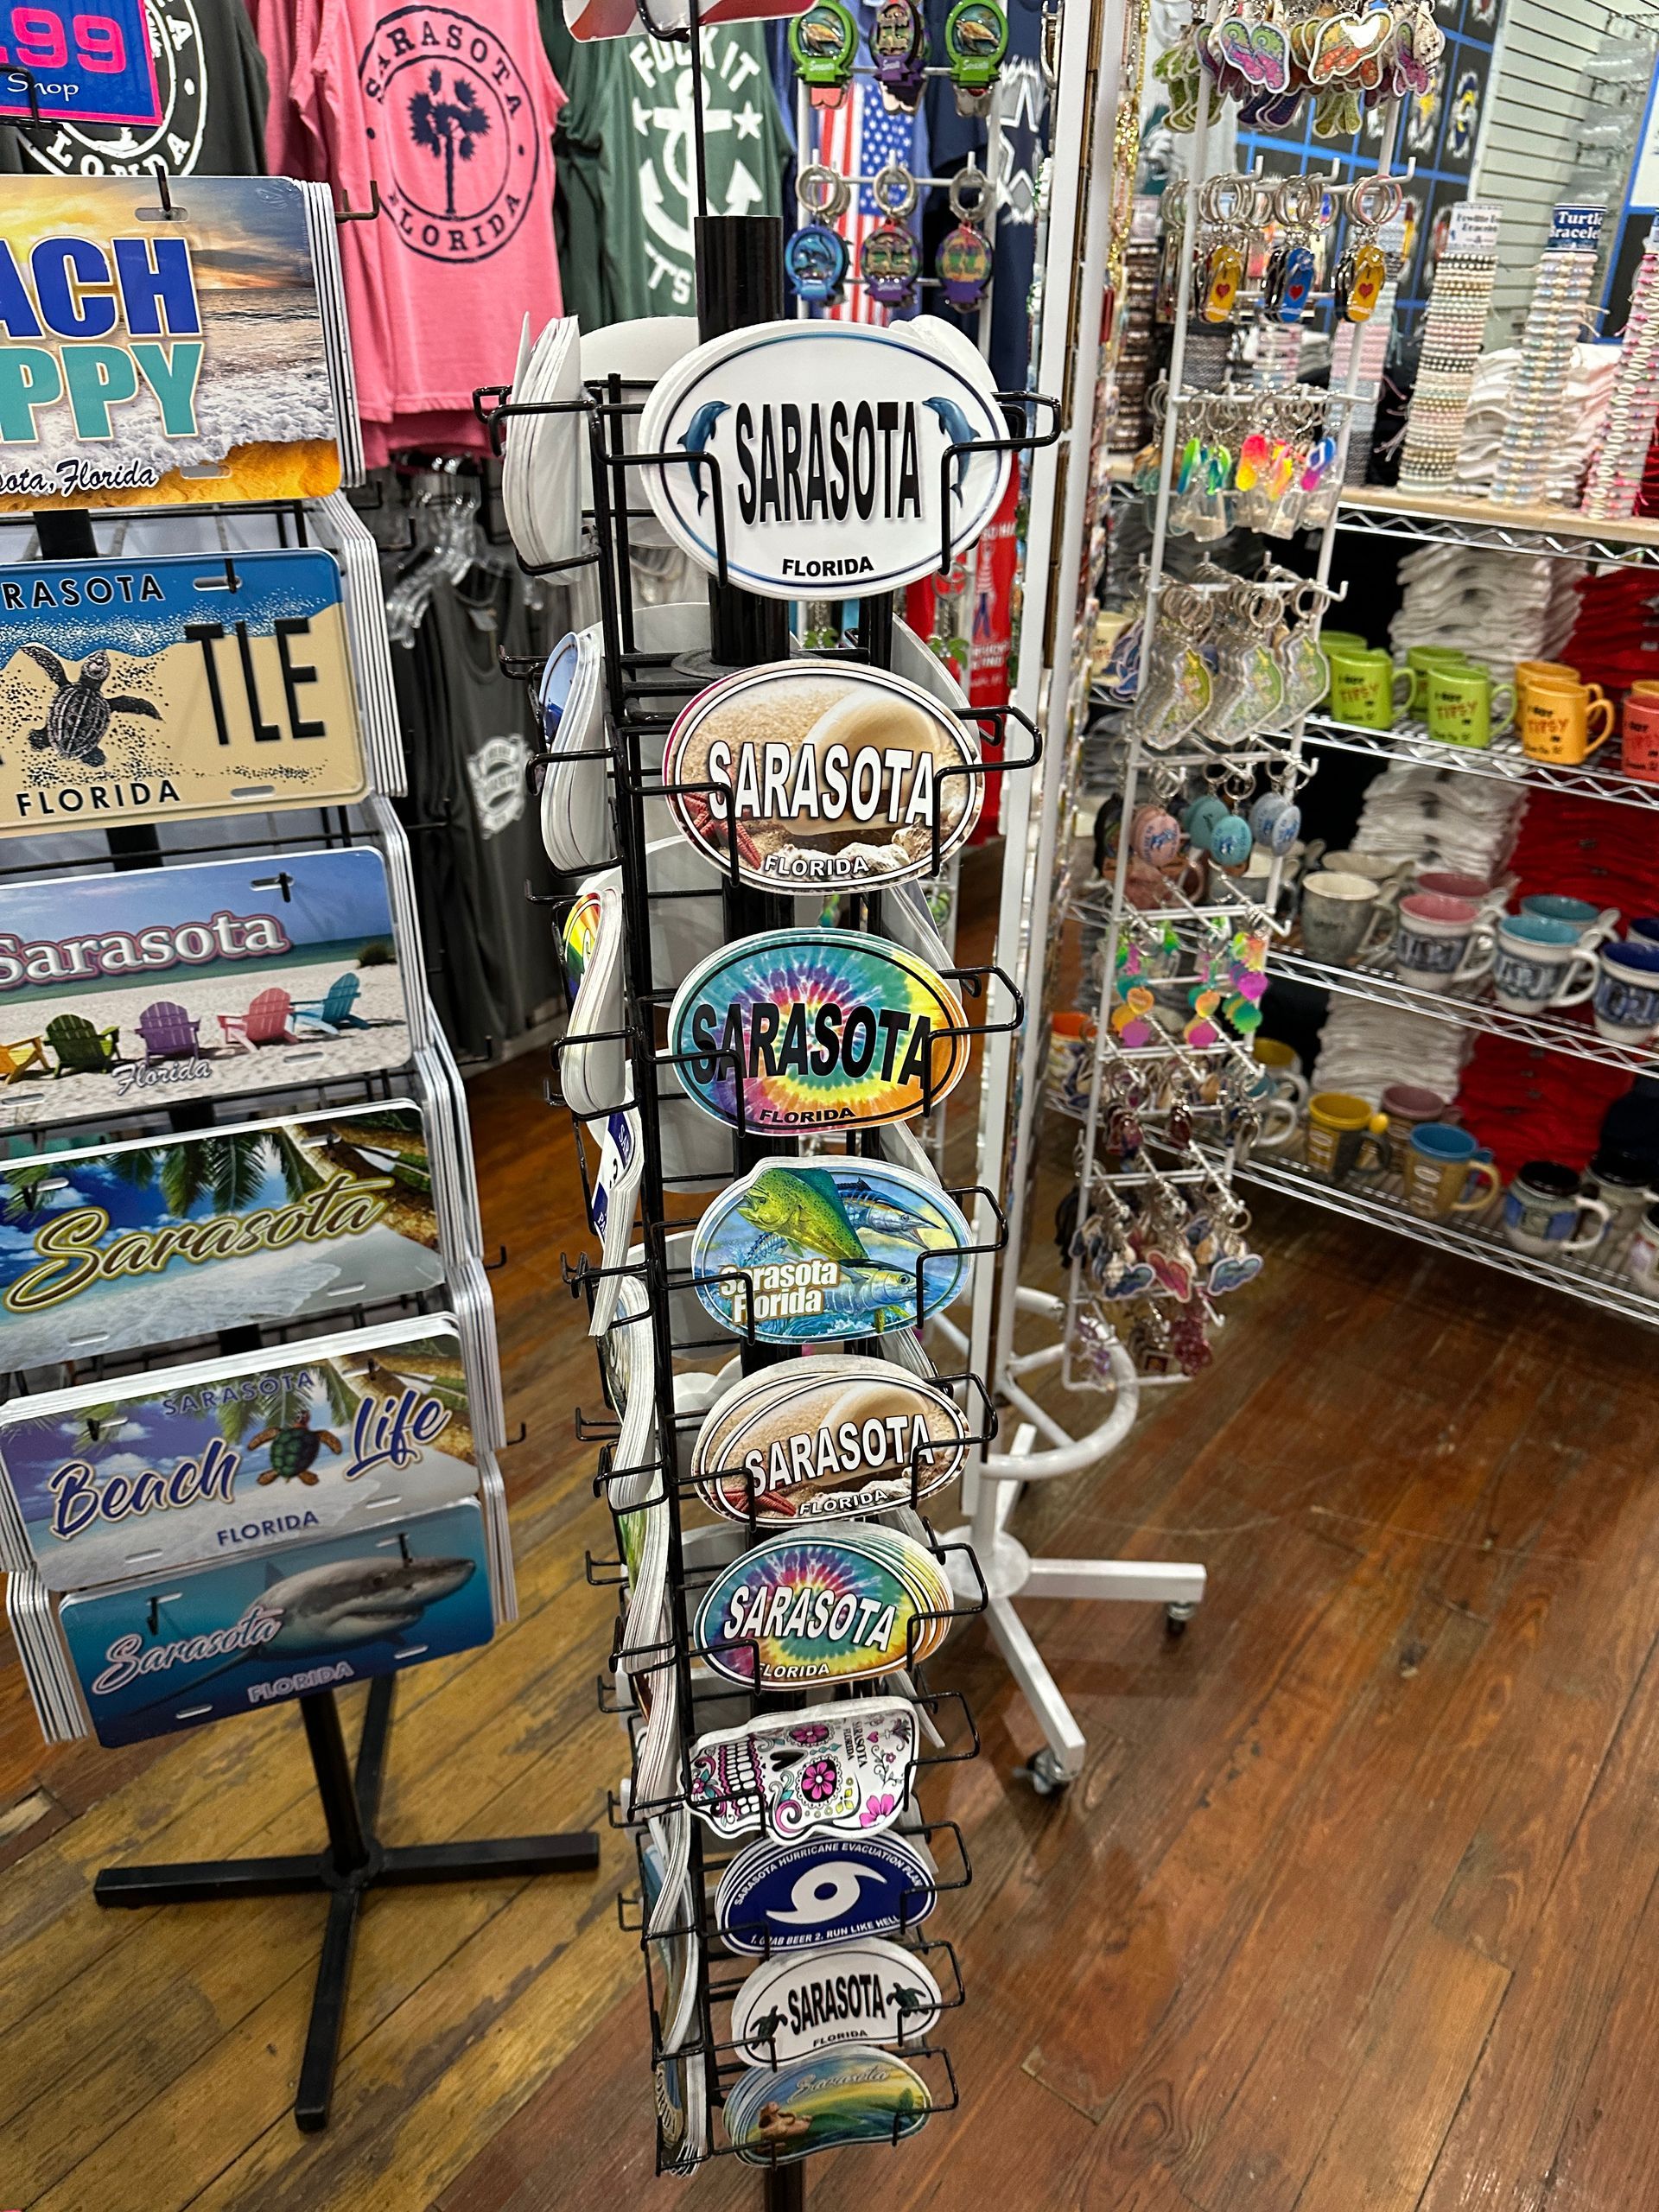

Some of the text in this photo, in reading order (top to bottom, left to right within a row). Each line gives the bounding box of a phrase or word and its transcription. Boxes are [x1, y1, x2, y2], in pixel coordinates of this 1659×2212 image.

[720, 41, 761, 92] IT
[55, 458, 157, 496] Florida
[736, 400, 921, 524] SARASOTA
[782, 556, 874, 576] FLORIDA
[1, 574, 166, 610] RASOTA
[184, 616, 327, 746] TLE
[16, 779, 181, 817] FLORIDA
[708, 740, 934, 827] SARASOTA
[764, 854, 870, 879] FLORIDA
[0, 912, 289, 987] Sarasota
[691, 1001, 932, 1090] SARASOTA
[111, 1058, 213, 1096] Florida
[759, 1108, 856, 1124] FLORIDA
[6, 1173, 395, 1313] Sarasota
[733, 1287, 823, 1325] Forida
[162, 1370, 315, 1416] SARASOTA
[48, 1389, 450, 1541] Beach Life
[744, 1414, 935, 1498] SARASOTA
[798, 1489, 889, 1516] FLORIDA
[217, 1510, 320, 1547] FLORIDA
[723, 1584, 897, 1653] SARASOTA
[92, 1605, 285, 1694] Sarasota
[246, 1660, 354, 1704] FLORIDA
[734, 1863, 778, 1905] SARASOTA
[778, 1843, 839, 1867] HURRICANE
[842, 1842, 905, 1869] EVACUATION
[786, 1934, 812, 1945] BEER
[826, 1927, 848, 1939] RUN
[850, 1921, 874, 1934] LIKE
[876, 1915, 900, 1929] HELL
[787, 1974, 887, 2035] SARASOTA
[812, 2029, 868, 2047] FLORIDA
